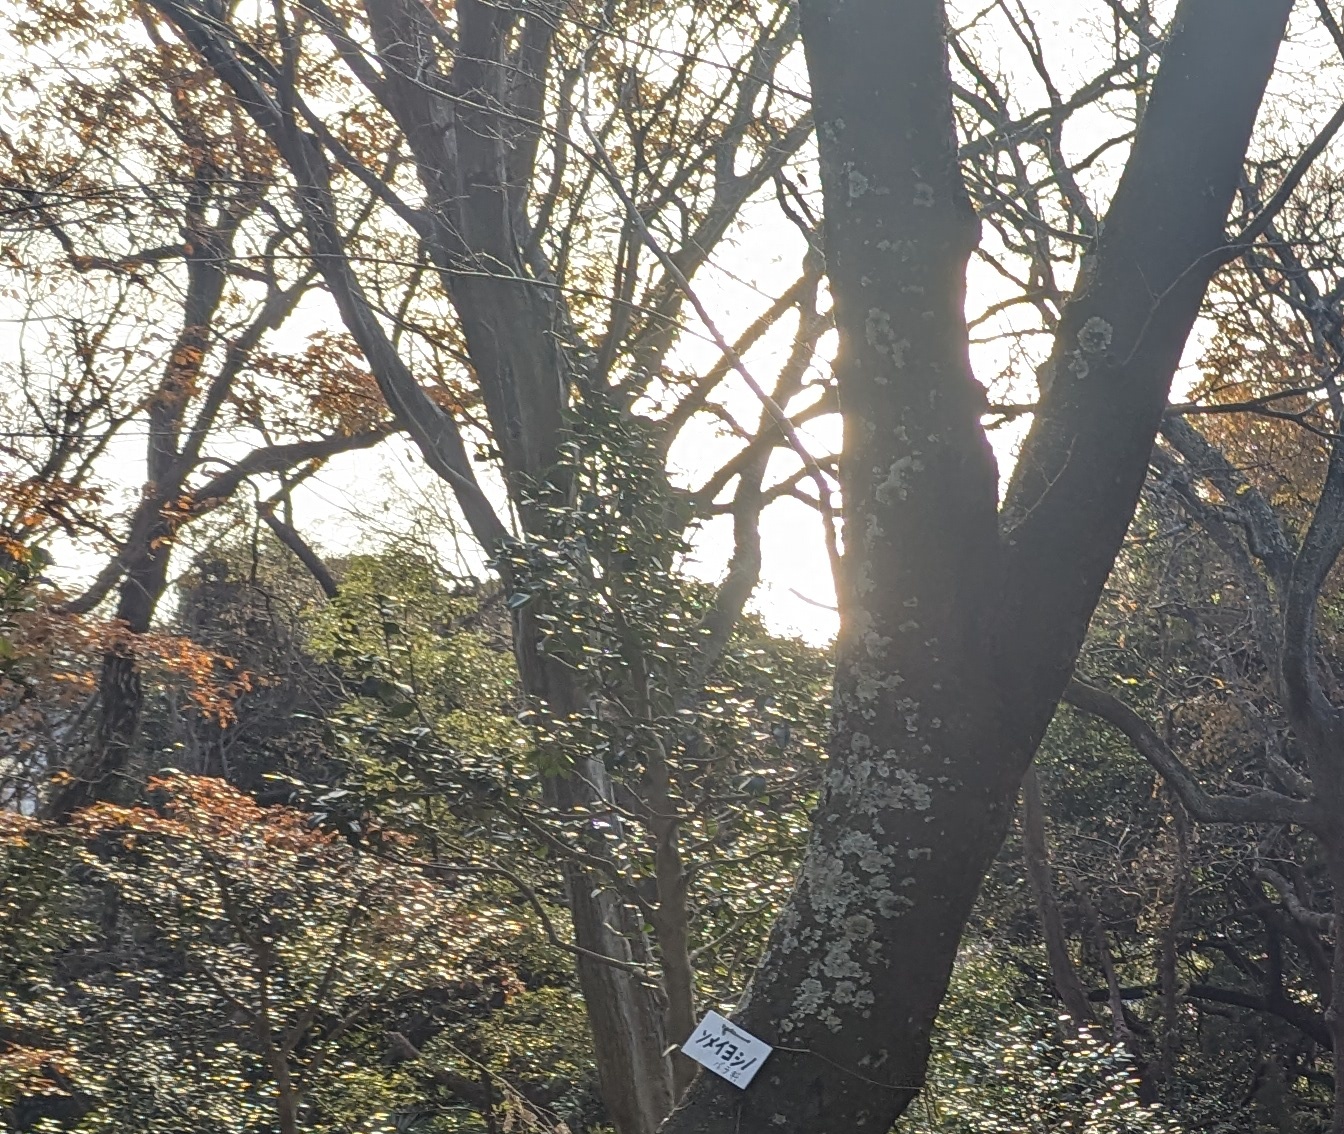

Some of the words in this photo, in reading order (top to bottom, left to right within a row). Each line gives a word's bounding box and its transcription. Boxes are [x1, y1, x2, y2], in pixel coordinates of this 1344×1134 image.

[695, 1029, 758, 1071] ソメイヨシノ
